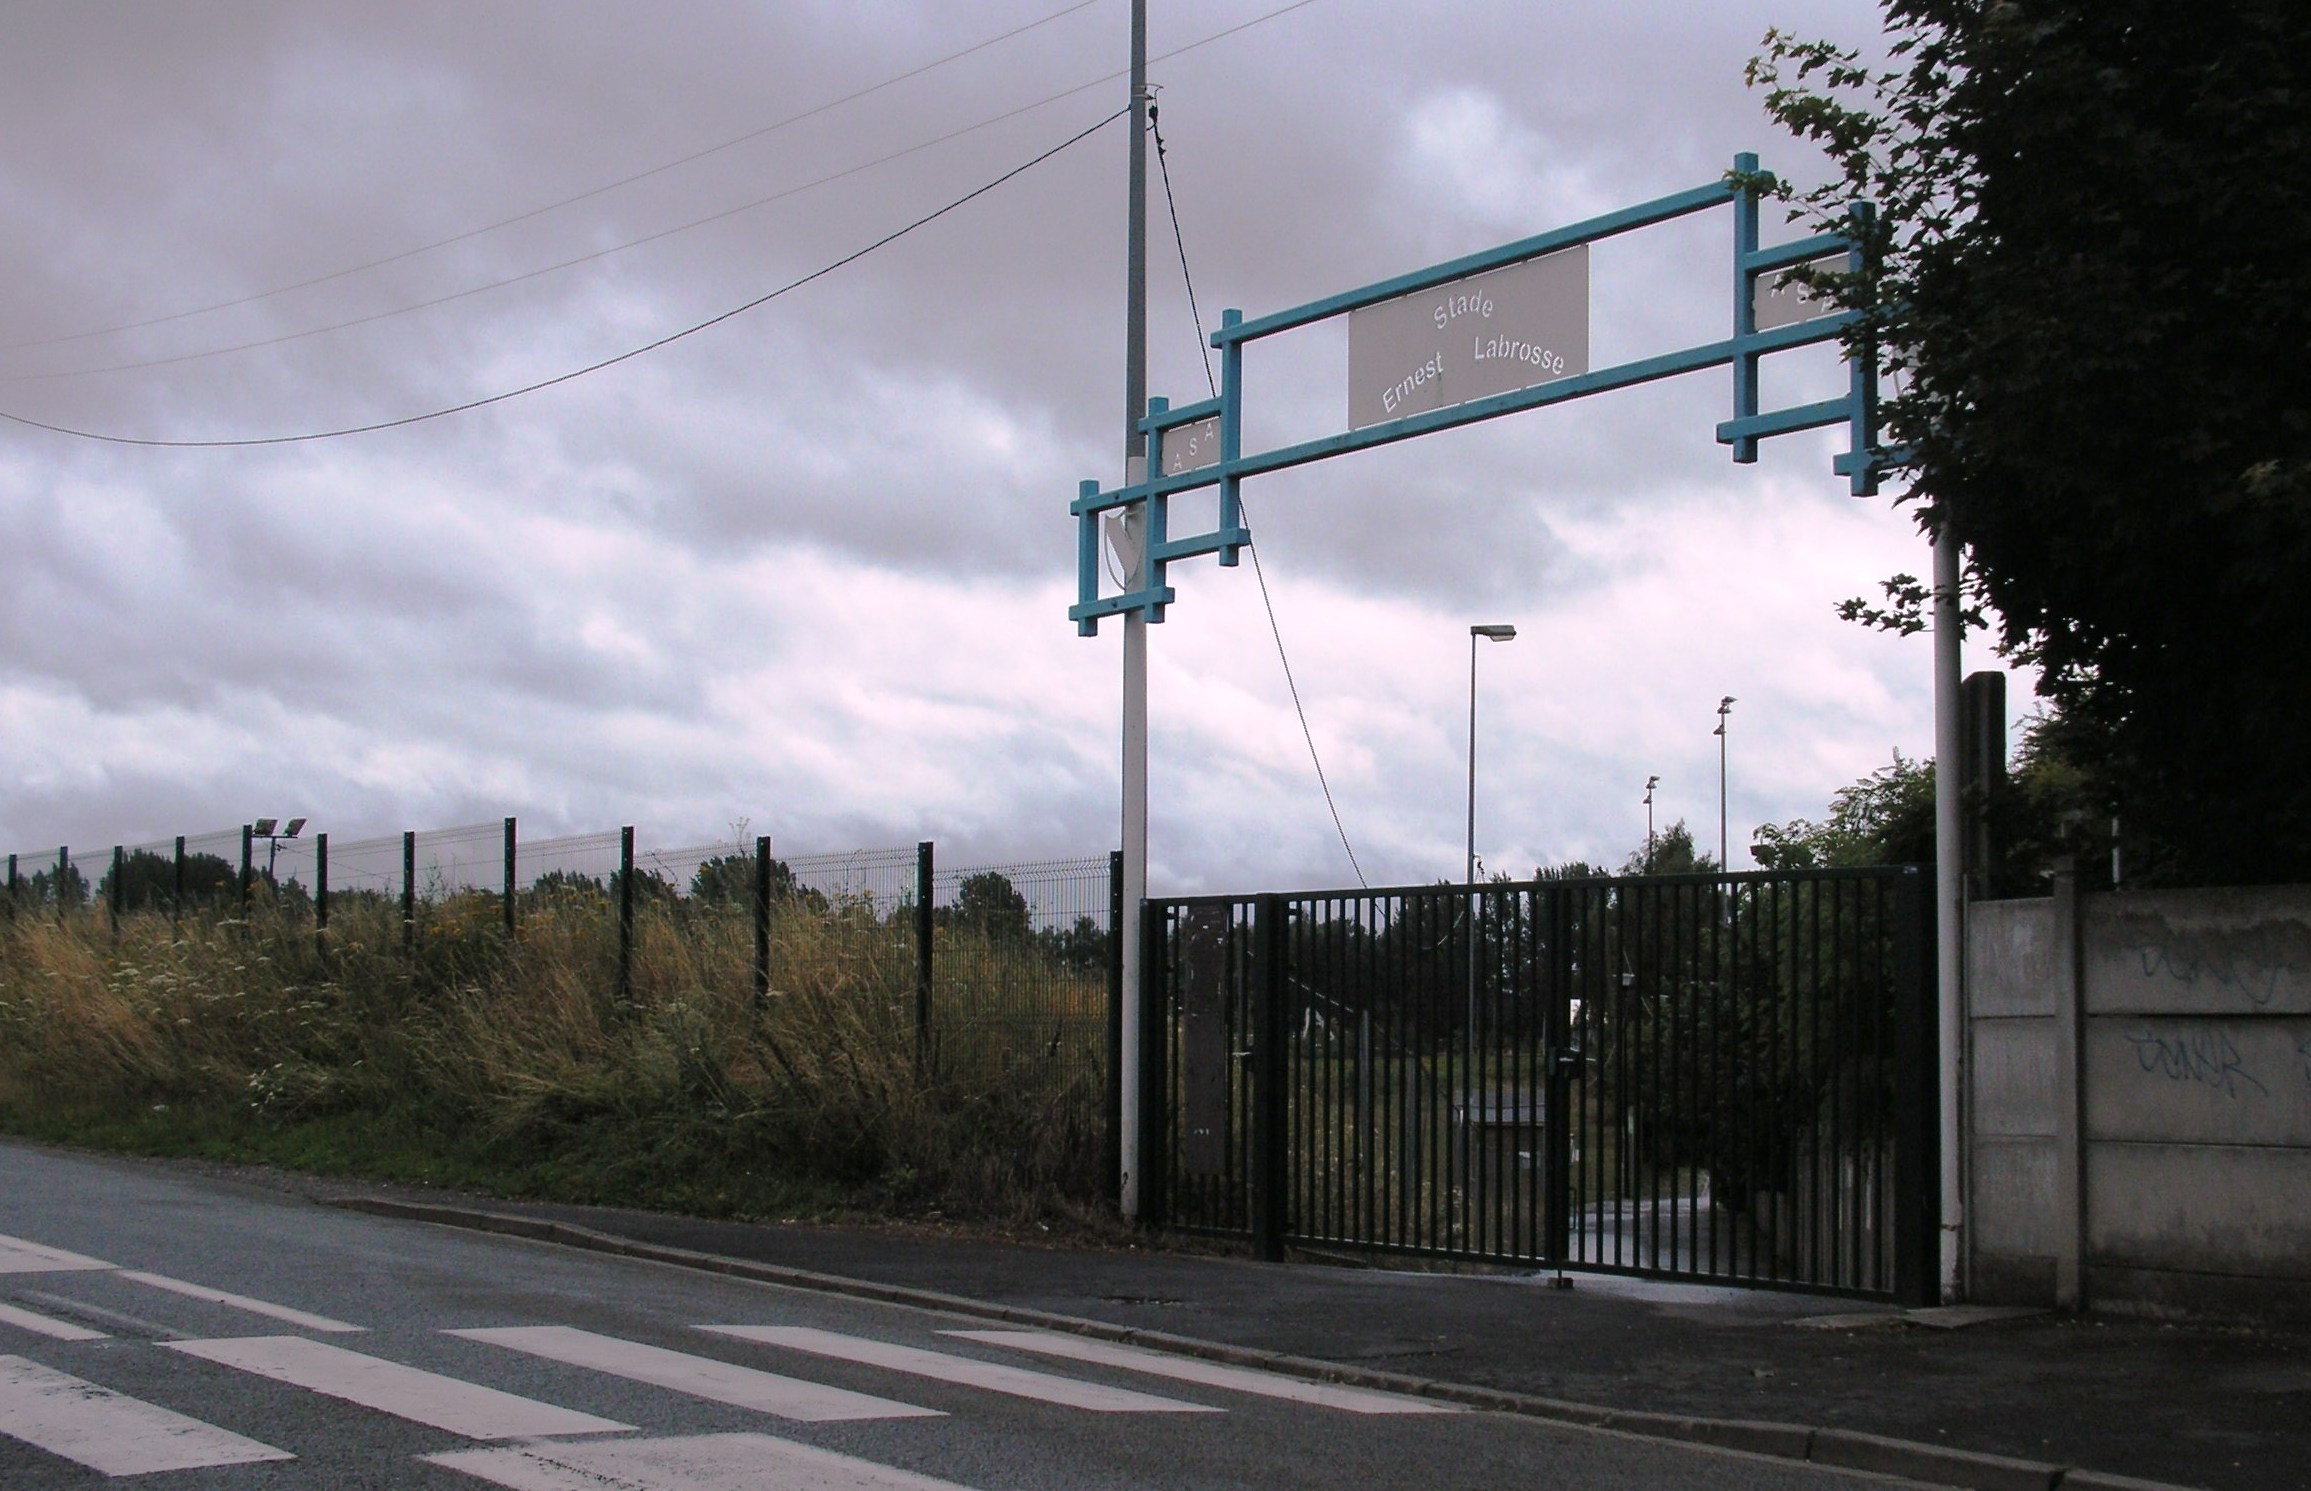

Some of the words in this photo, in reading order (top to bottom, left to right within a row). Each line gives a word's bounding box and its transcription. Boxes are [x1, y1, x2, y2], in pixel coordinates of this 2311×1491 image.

[1434, 289, 1493, 329] Stade
[1383, 351, 1444, 413] Ernest
[1474, 334, 1564, 374] Labrosse
